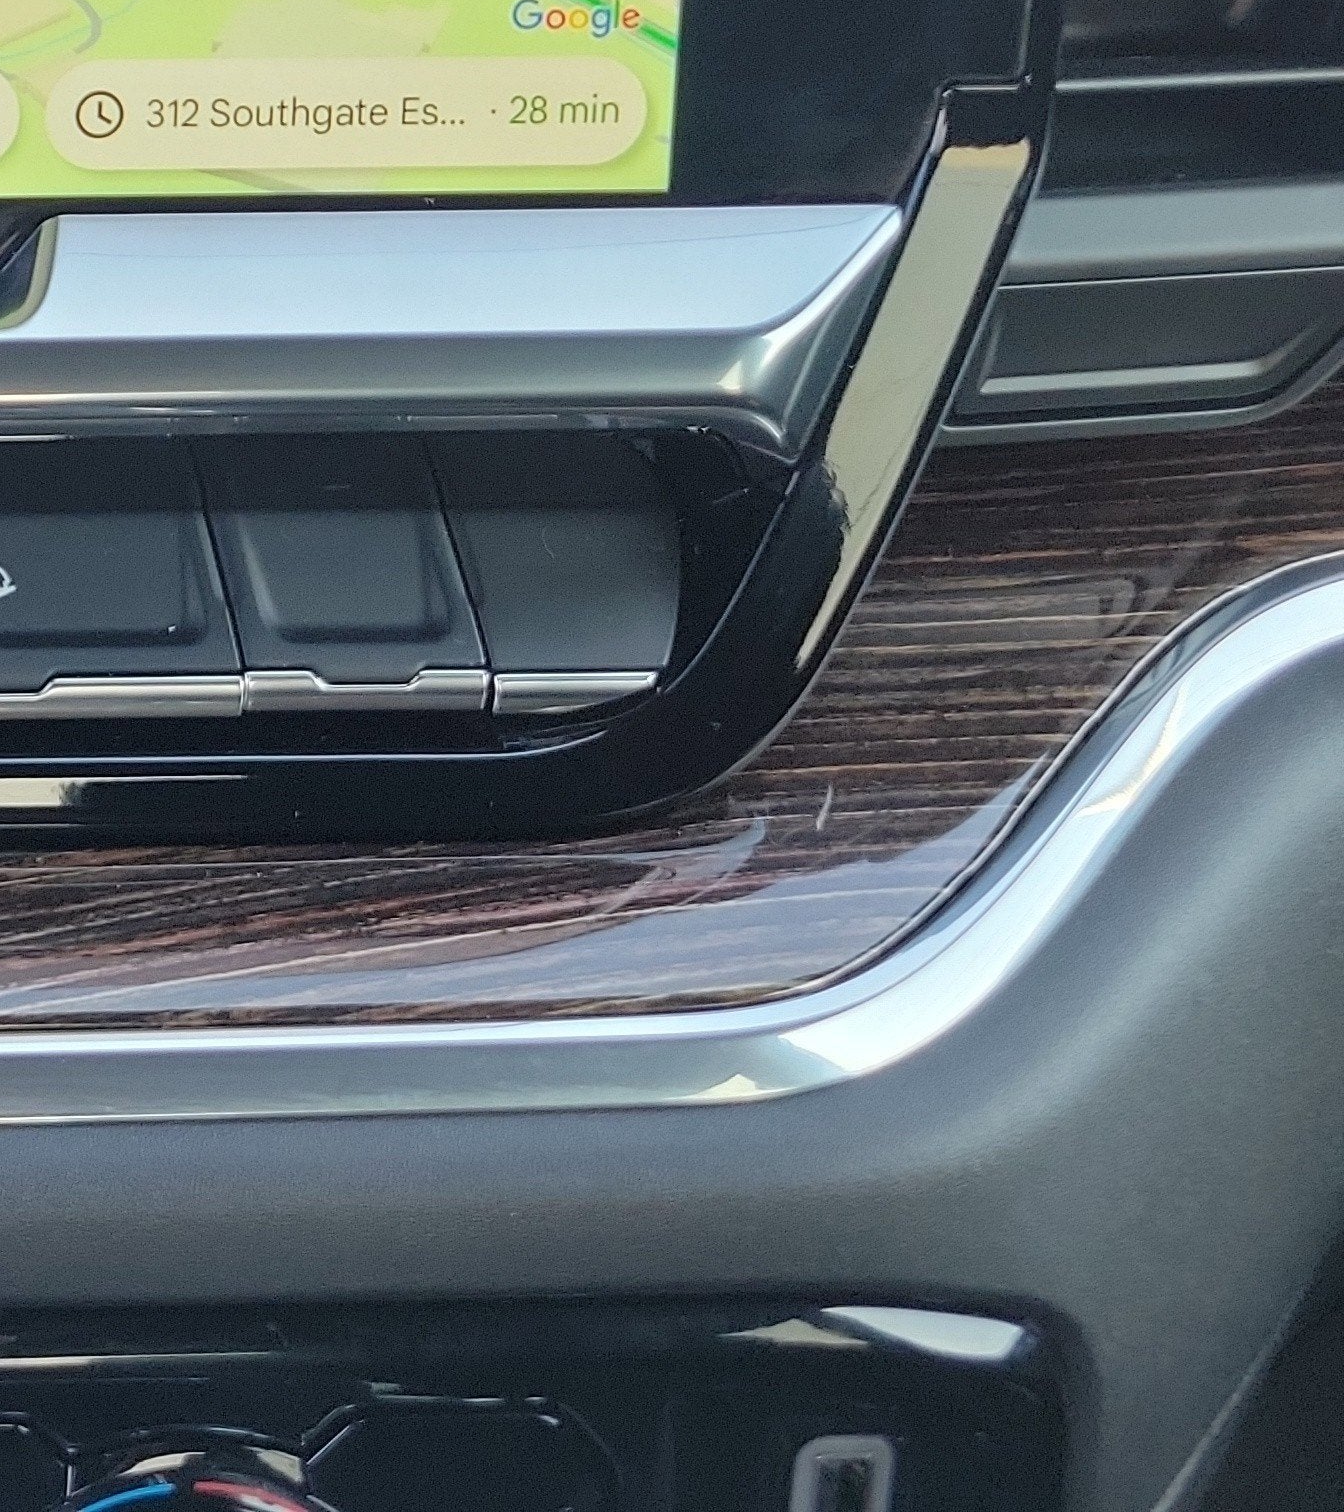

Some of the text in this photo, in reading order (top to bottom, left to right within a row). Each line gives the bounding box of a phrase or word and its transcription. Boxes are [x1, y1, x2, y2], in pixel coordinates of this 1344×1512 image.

[146, 96, 466, 135] 312 Southgate Es...
[509, 93, 620, 125] 28 min
